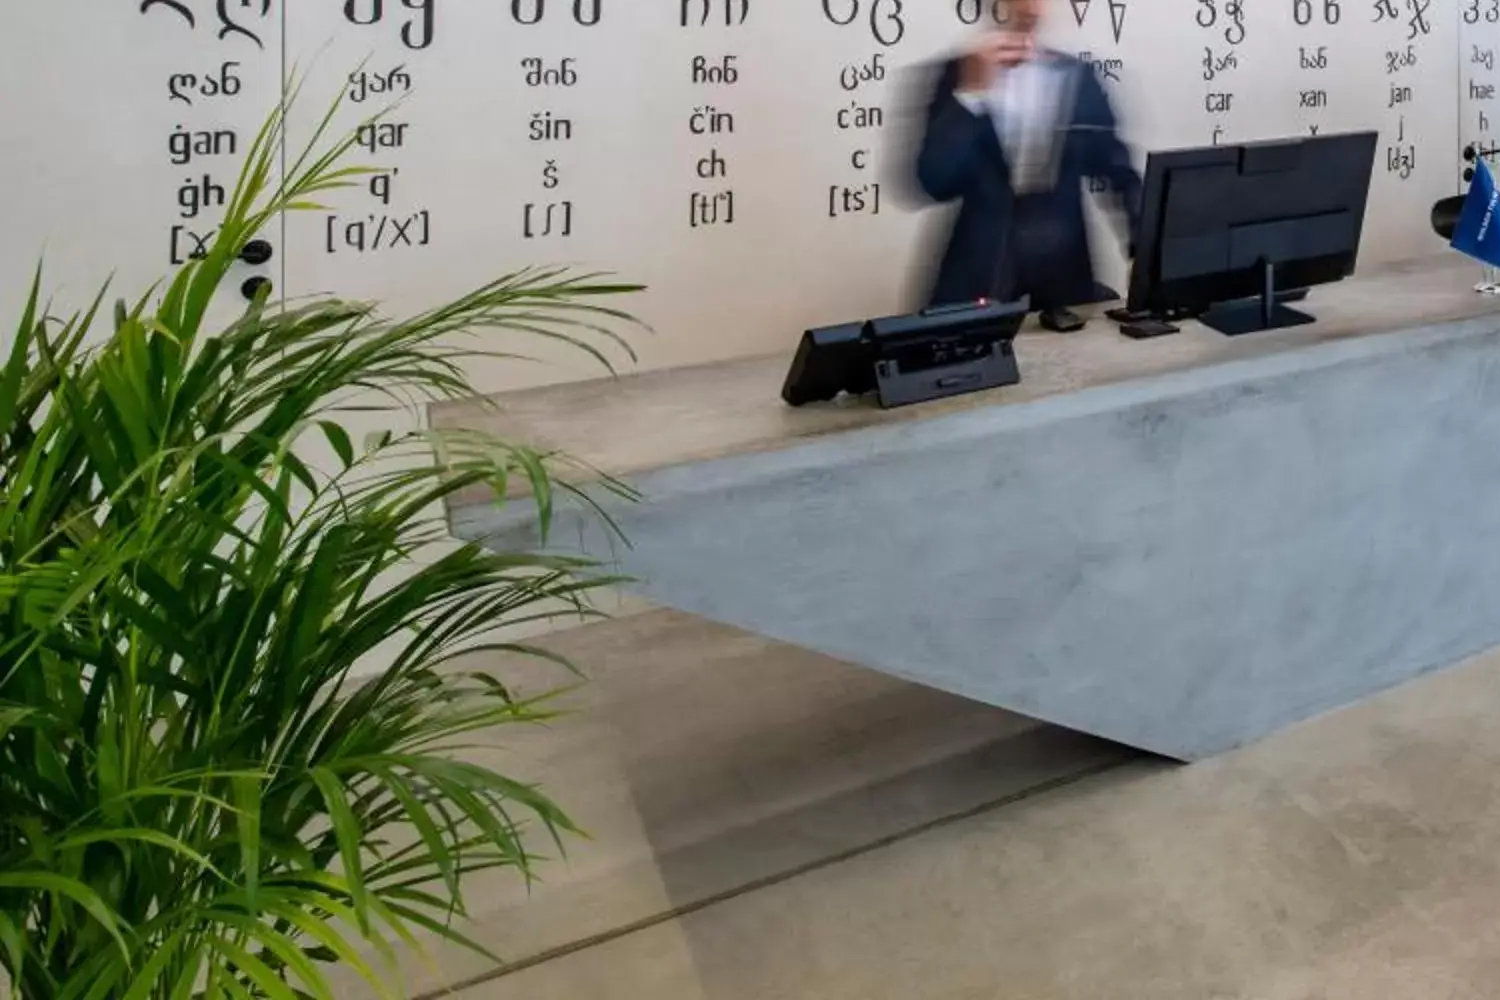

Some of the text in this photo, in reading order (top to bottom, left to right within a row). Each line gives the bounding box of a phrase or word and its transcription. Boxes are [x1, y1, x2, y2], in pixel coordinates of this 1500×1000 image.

[521, 56, 577, 88] შინ
[693, 56, 738, 84] ჩინ
[840, 54, 885, 91] ცან
[1300, 47, 1328, 70] ხან
[168, 61, 241, 105] ღან
[348, 64, 411, 103] ყარ
[1387, 84, 1412, 108] jan
[1469, 83, 1495, 101] hae
[1300, 88, 1327, 109] xan
[357, 120, 409, 151] qar
[529, 113, 571, 141] šin
[1479, 112, 1488, 132] h
[697, 149, 726, 179] ch
